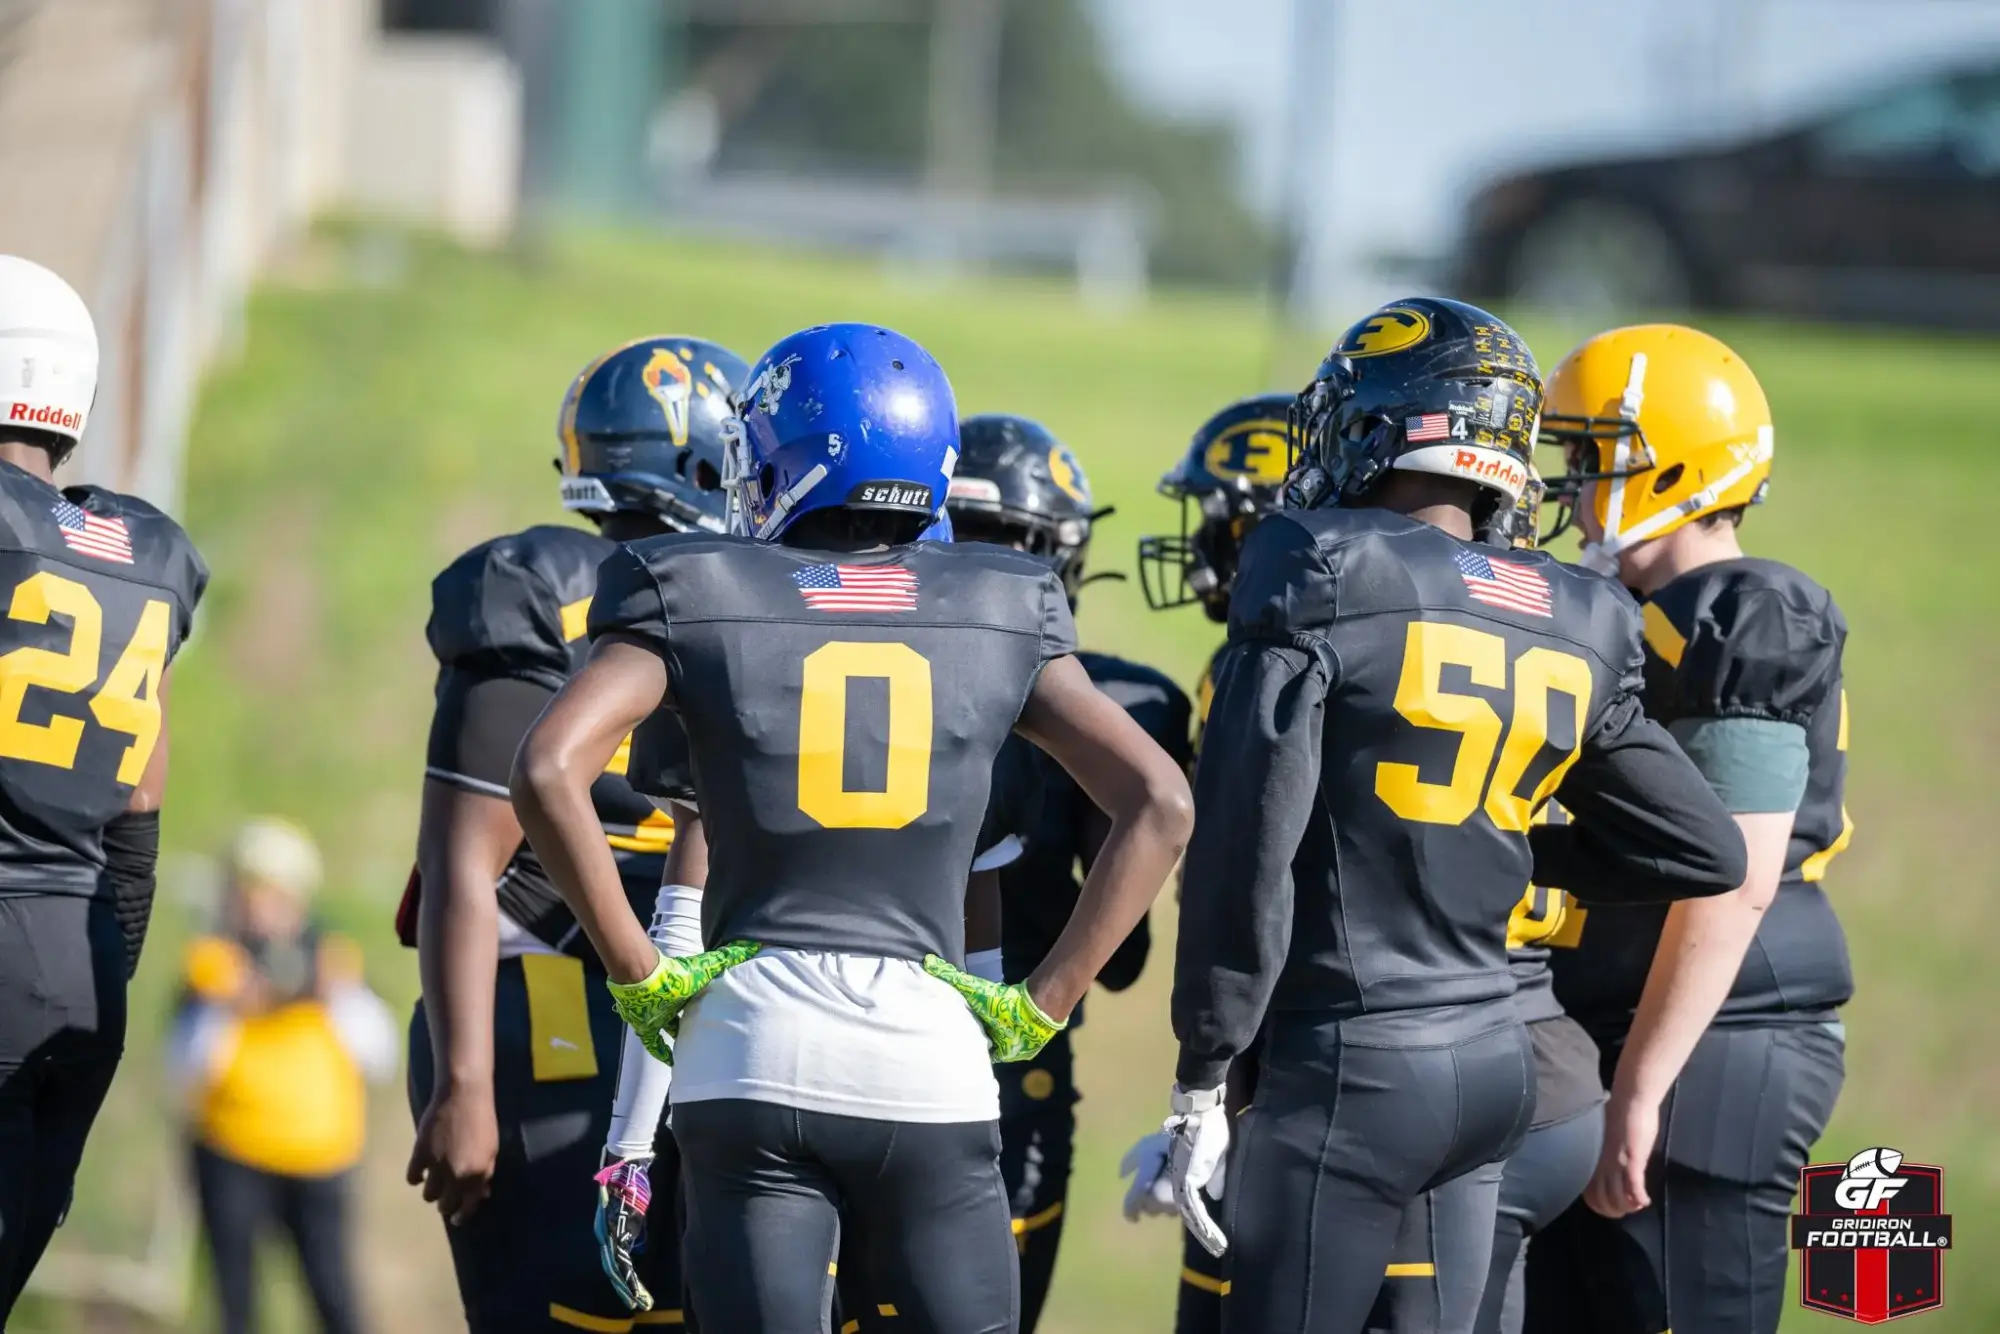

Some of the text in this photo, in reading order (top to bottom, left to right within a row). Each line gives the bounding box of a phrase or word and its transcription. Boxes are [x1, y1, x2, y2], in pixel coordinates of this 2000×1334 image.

[9, 402, 81, 431] Riddell
[1451, 417, 1468, 440] 4
[862, 484, 930, 506] schutt
[0, 571, 170, 786] 24
[1375, 621, 1592, 835] 50
[798, 641, 933, 829] 0
